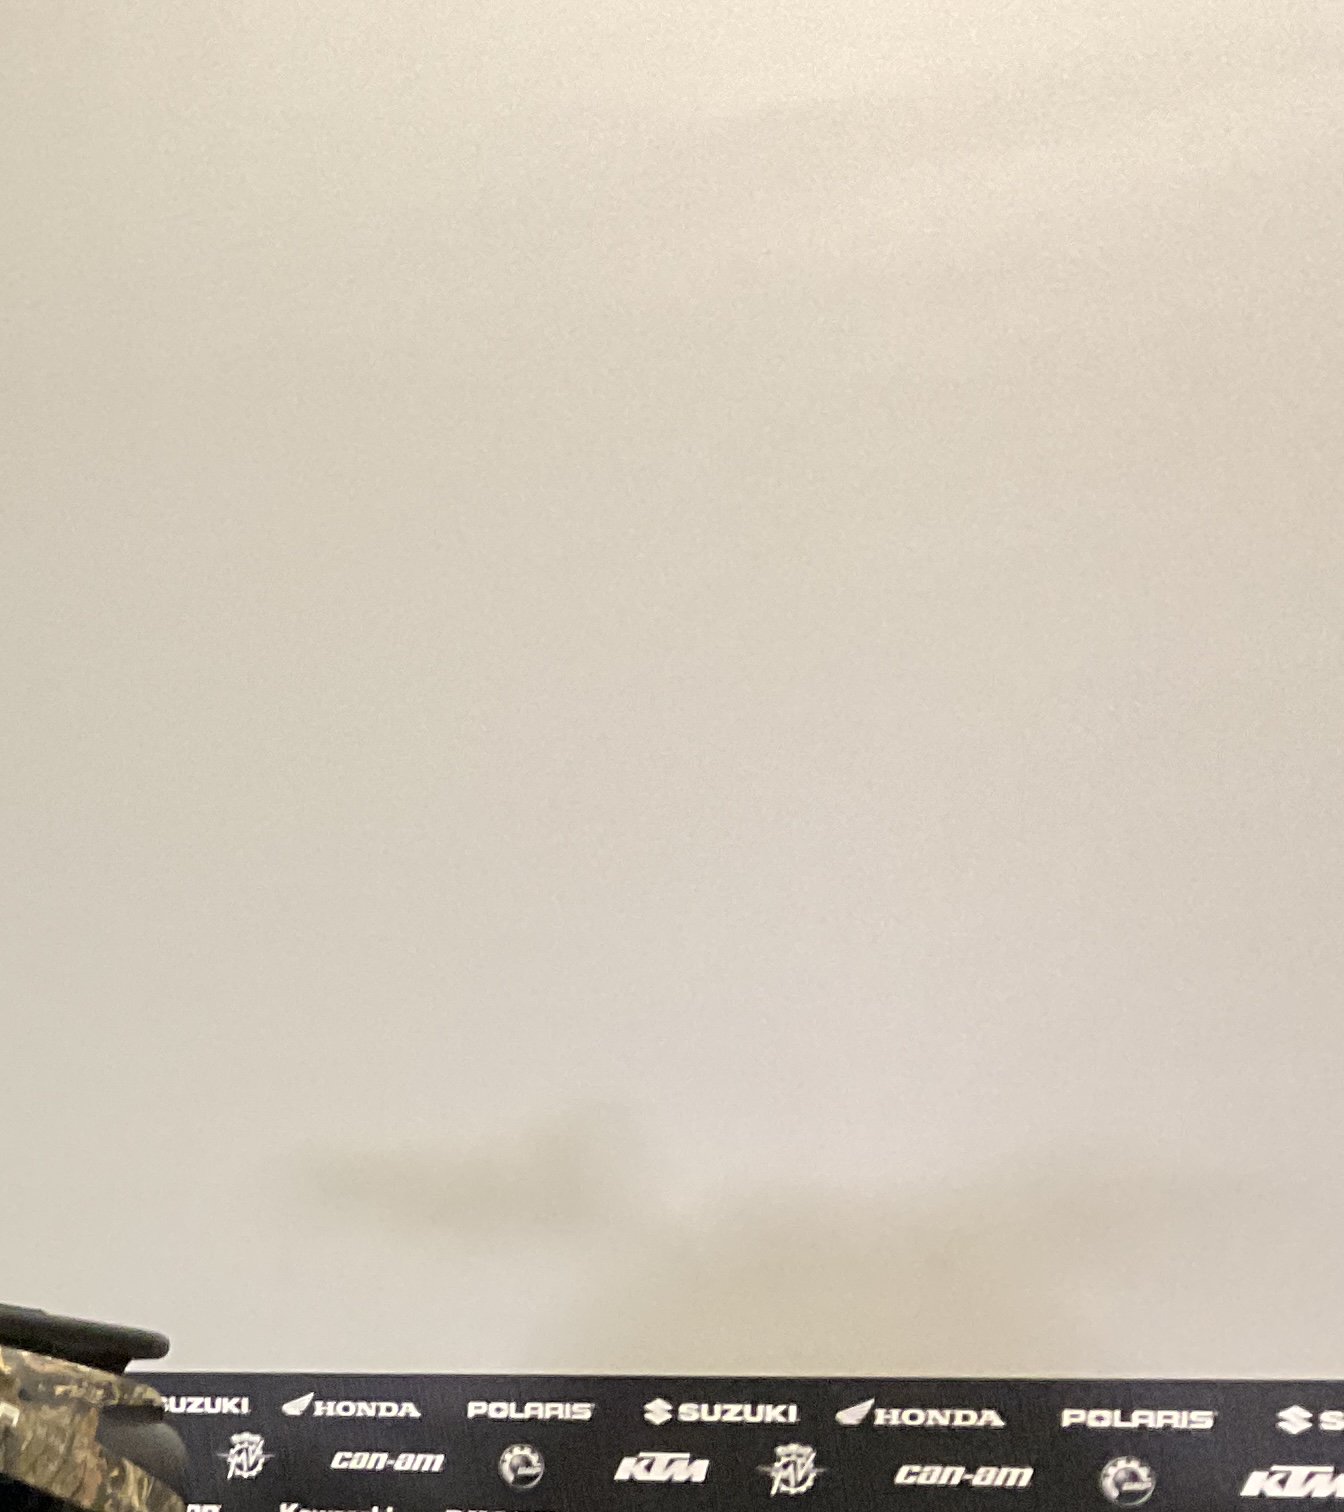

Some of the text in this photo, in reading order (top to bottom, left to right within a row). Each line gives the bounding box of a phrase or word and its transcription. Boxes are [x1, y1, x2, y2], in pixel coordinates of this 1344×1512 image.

[313, 1400, 421, 1418] HONDA
[467, 1401, 593, 1421] POLARIS
[678, 1402, 800, 1425] SUZUKI
[873, 1408, 1006, 1428] HONDA
[1061, 1408, 1216, 1431] POLARIS
[329, 1451, 445, 1473] can-am
[614, 1451, 710, 1484] KTM
[893, 1464, 1034, 1489] can-am
